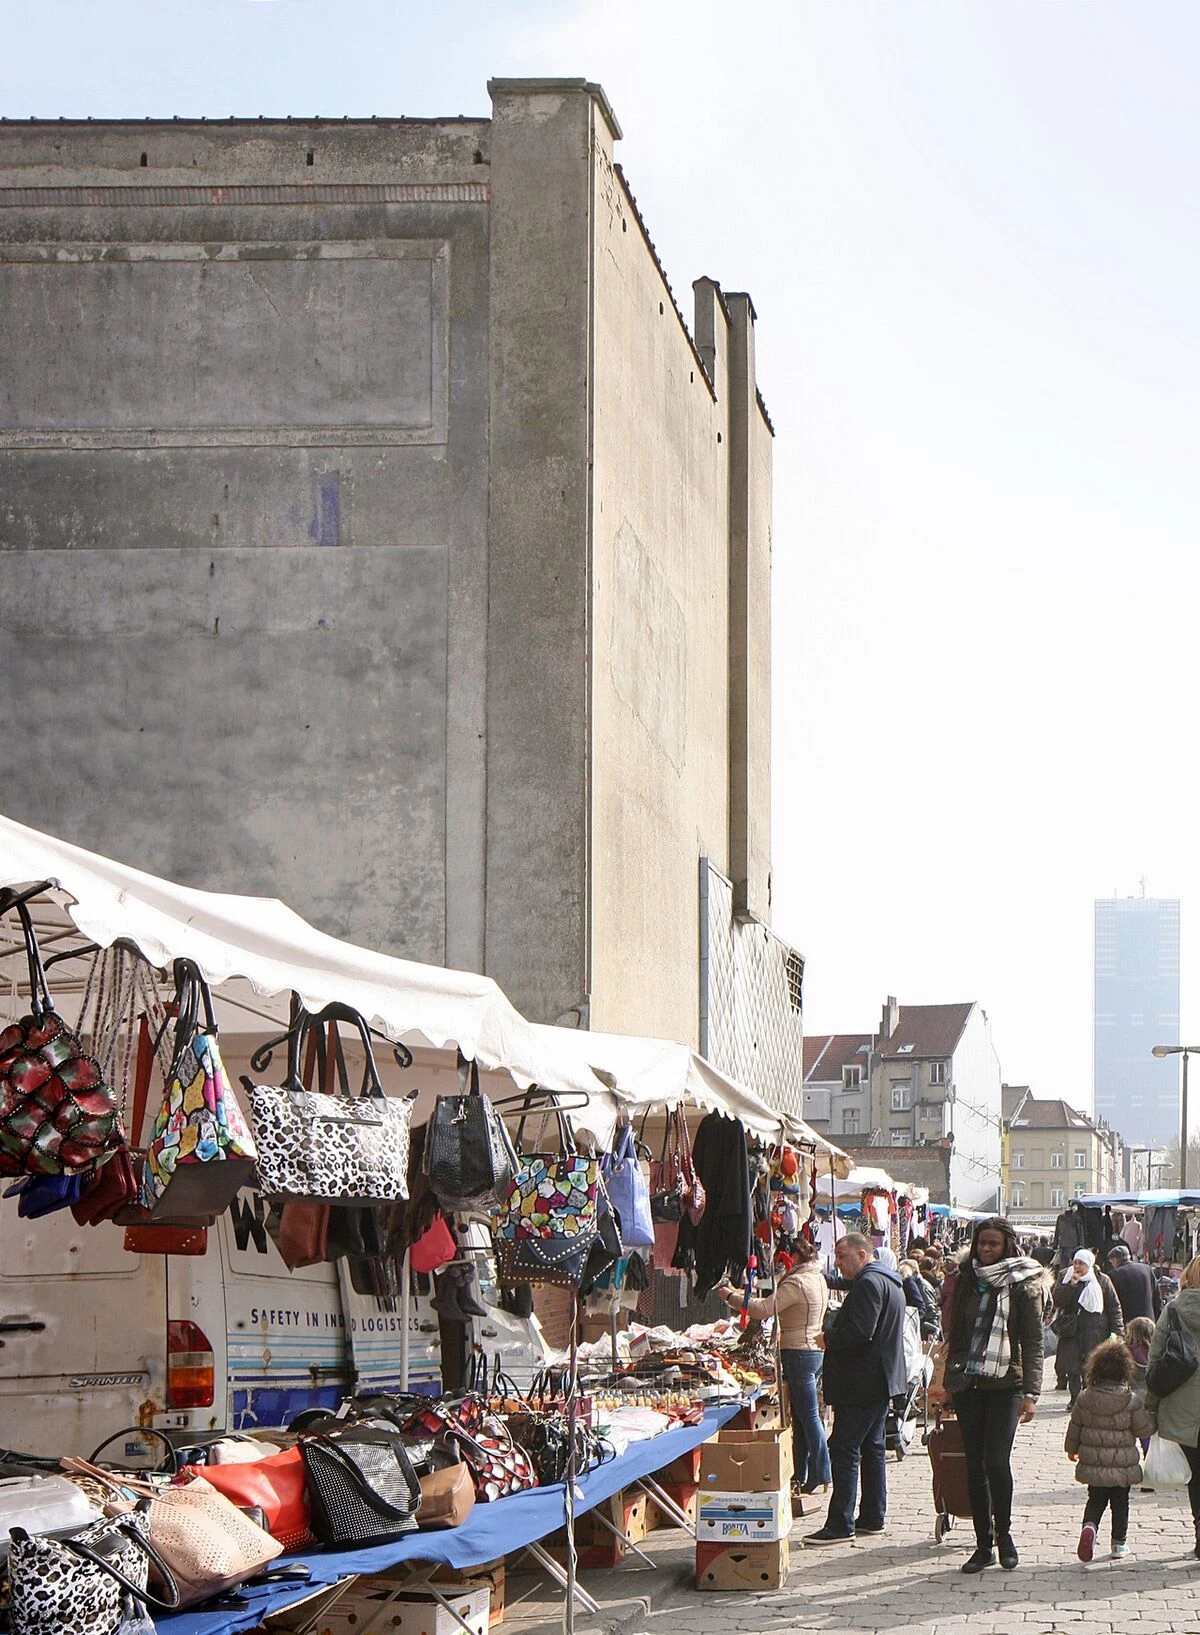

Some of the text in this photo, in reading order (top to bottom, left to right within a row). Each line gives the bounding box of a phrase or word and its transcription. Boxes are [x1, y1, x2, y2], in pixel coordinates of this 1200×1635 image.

[251, 1308, 300, 1326] SAFETY
[306, 1312, 319, 1327] IN
[362, 1317, 420, 1333] LOGISTCS
[722, 1522, 749, 1536] BONITA
